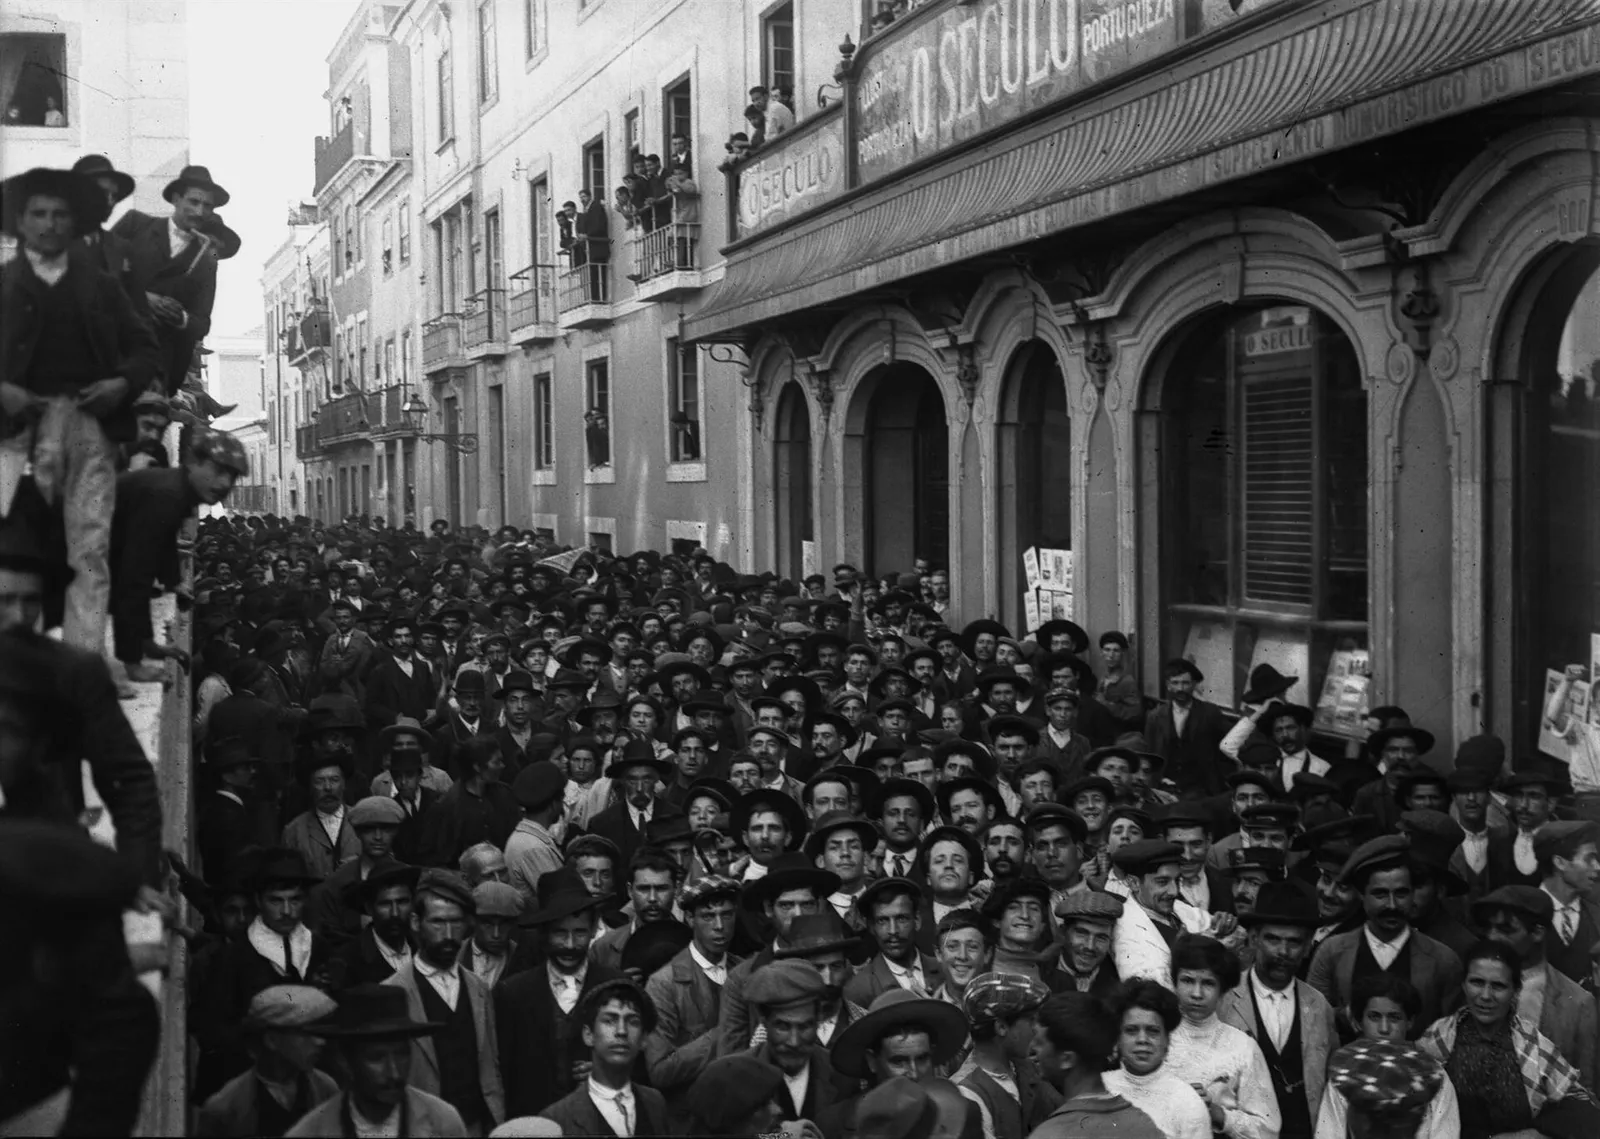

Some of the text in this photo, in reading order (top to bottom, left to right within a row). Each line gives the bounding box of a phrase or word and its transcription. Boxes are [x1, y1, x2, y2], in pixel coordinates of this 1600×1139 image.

[1082, 0, 1175, 57] PORTUGUEZA
[912, 48, 930, 140] O
[938, 0, 1078, 127] SECULO
[1480, 61, 1508, 99] DO
[1530, 31, 1600, 82] SECU
[748, 147, 831, 215] O SECULO
[1248, 335, 1256, 353] O
